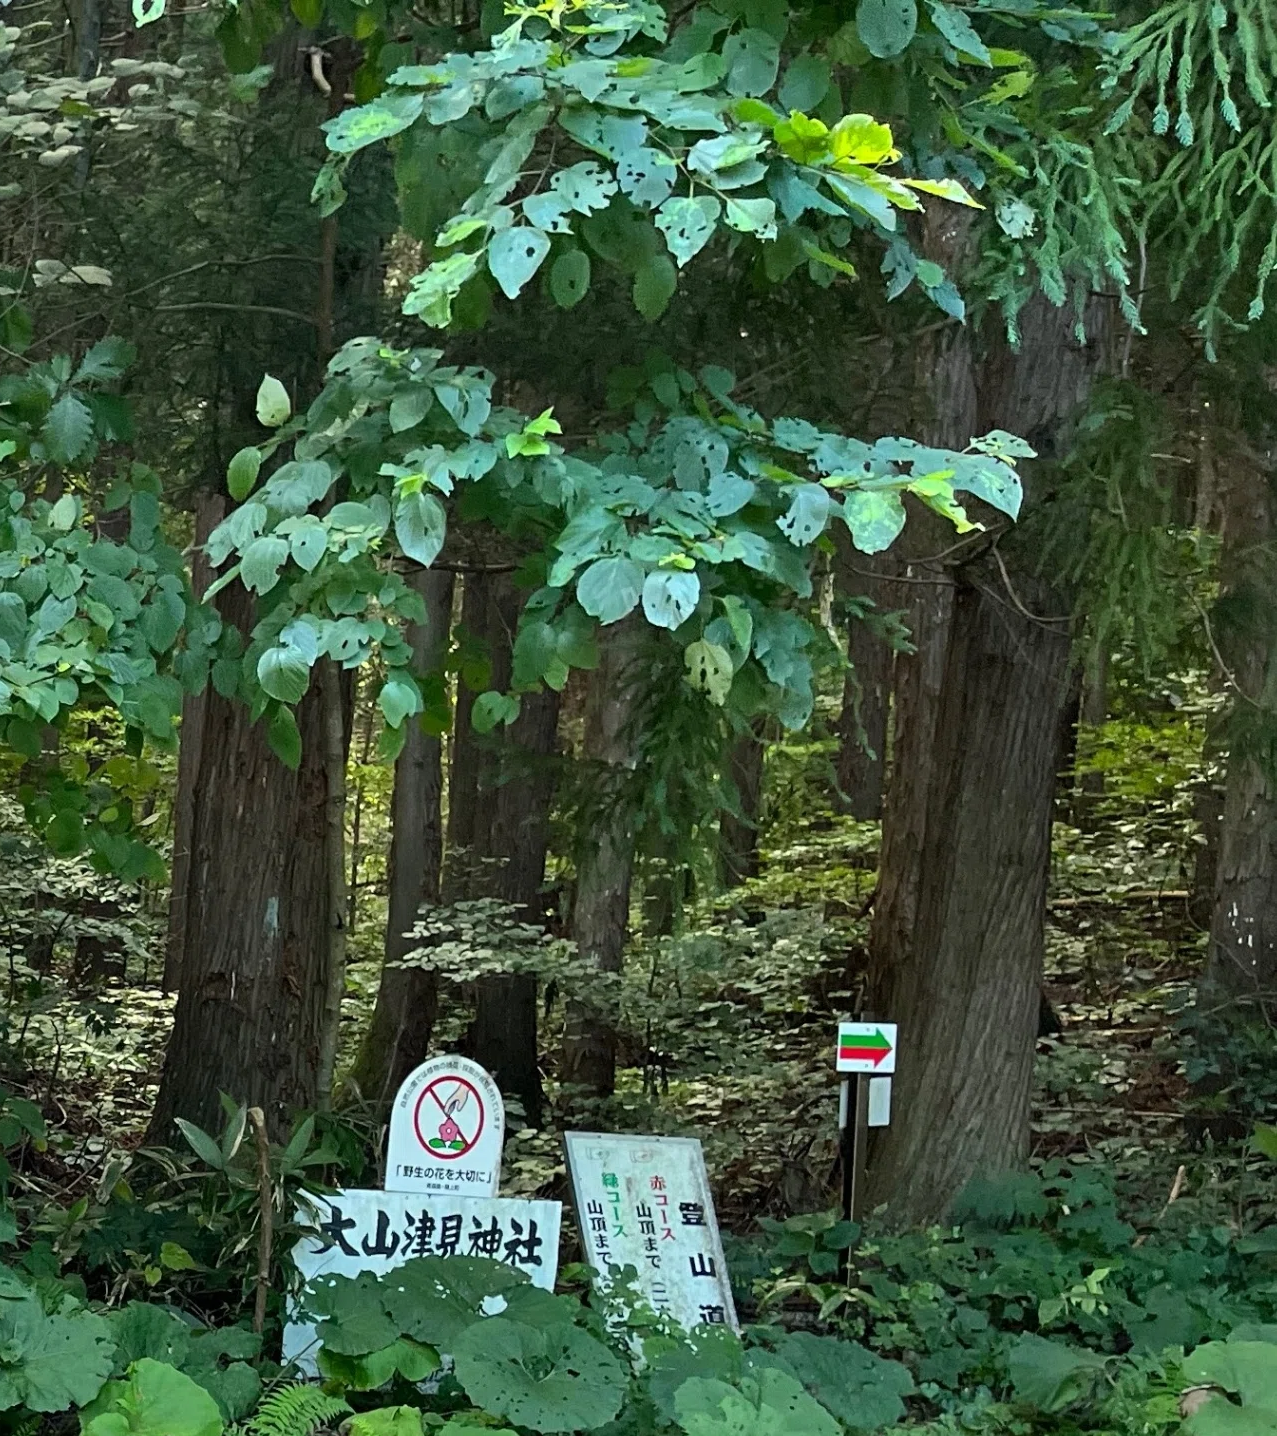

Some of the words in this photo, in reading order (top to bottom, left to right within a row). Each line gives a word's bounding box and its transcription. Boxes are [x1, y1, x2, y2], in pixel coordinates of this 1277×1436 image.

[310, 1205, 544, 1267] 大山津見神社
[601, 1172, 628, 1238] 緑コース
[650, 1175, 676, 1241] 赤コース
